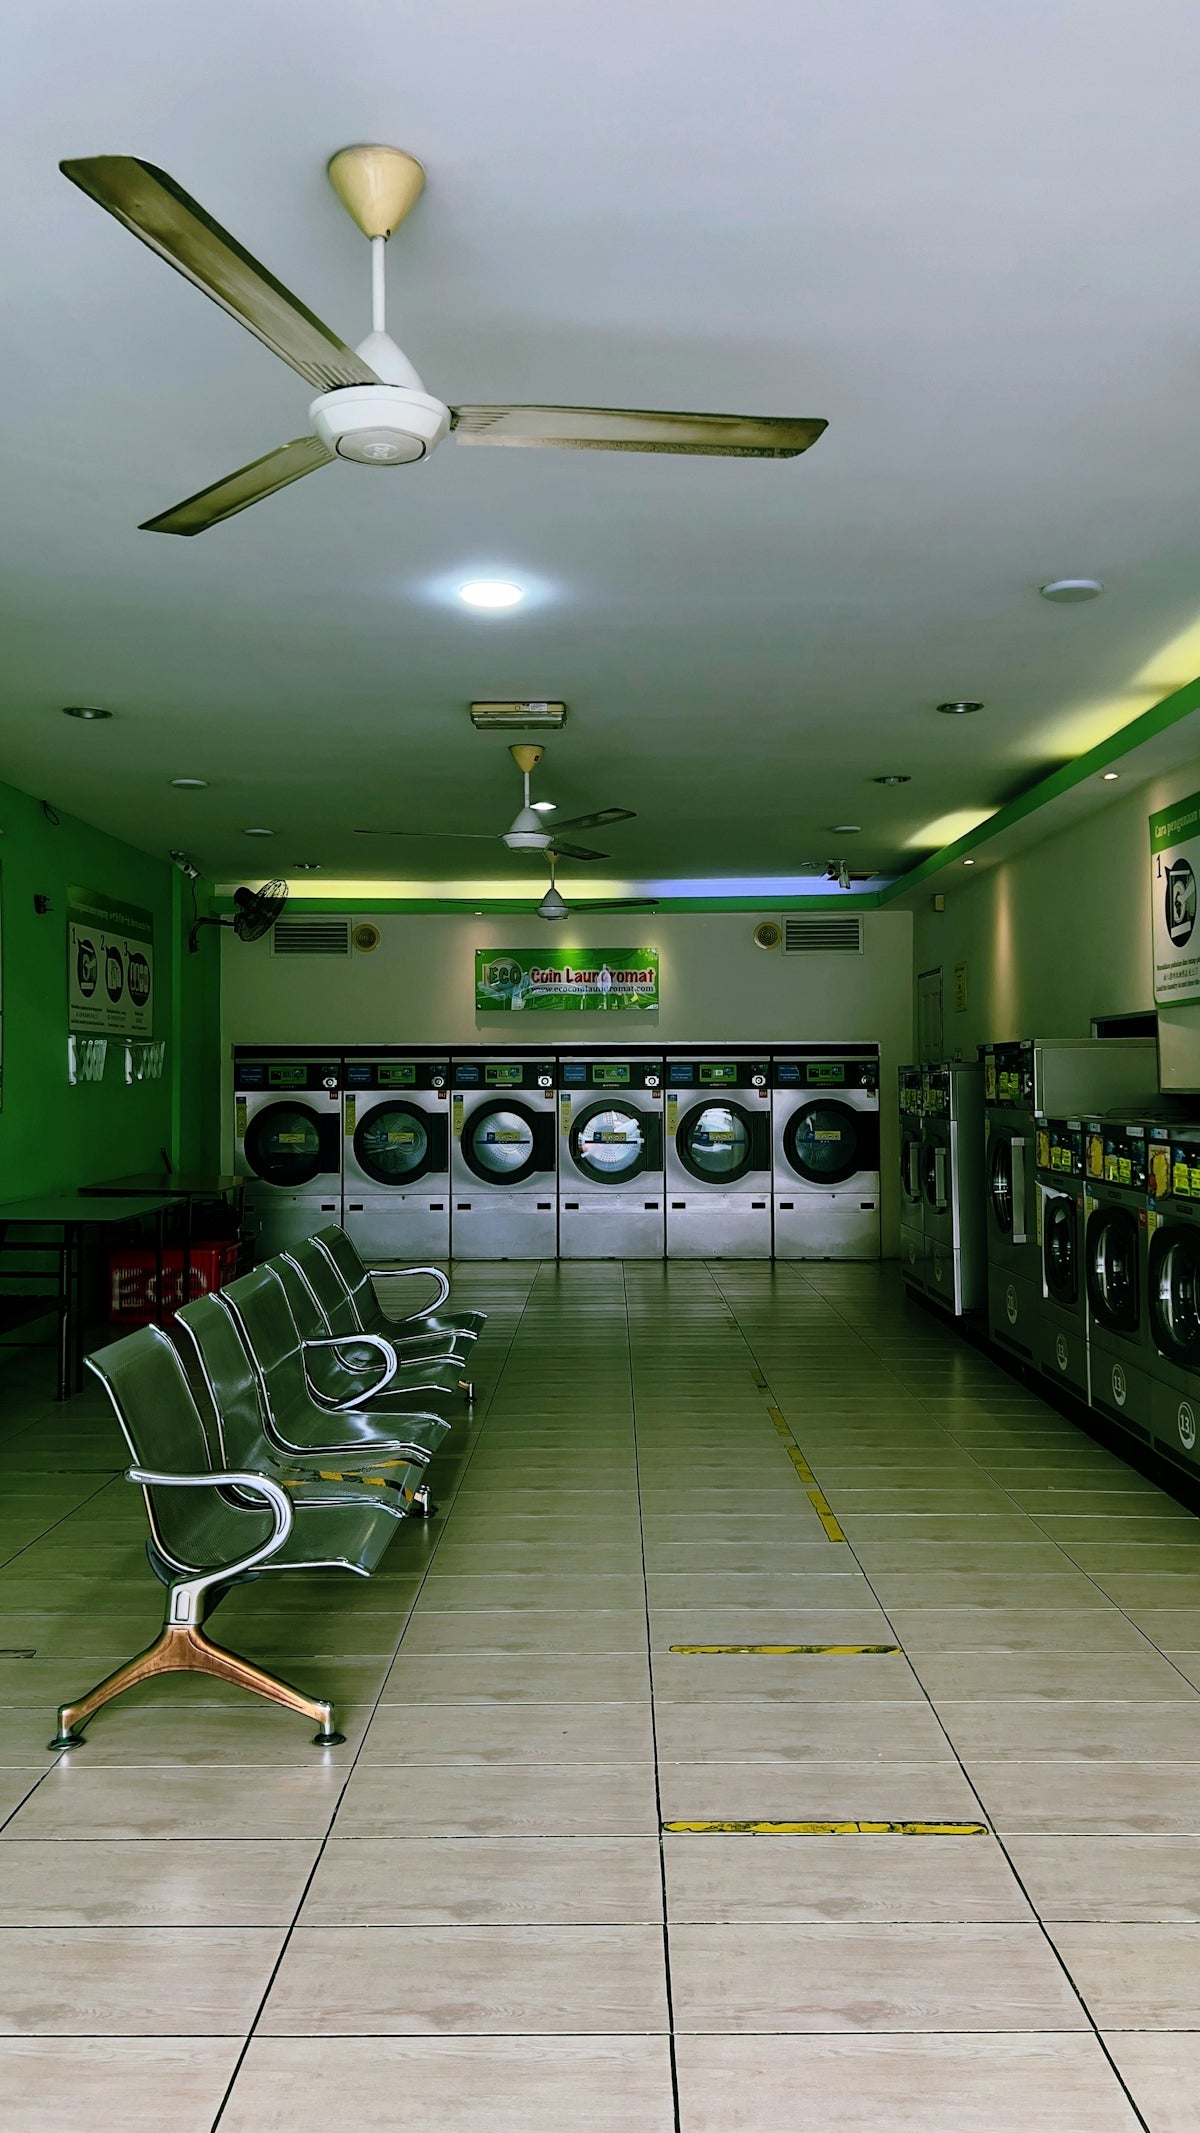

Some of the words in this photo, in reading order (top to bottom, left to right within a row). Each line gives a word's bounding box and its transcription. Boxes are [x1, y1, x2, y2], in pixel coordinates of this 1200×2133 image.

[1156, 853, 1161, 879] 1
[100, 935, 105, 951] 2
[123, 941, 128, 956] 3
[489, 966, 522, 985] ECO
[531, 968, 562, 983] Coin
[1180, 1413, 1190, 1434] 13
